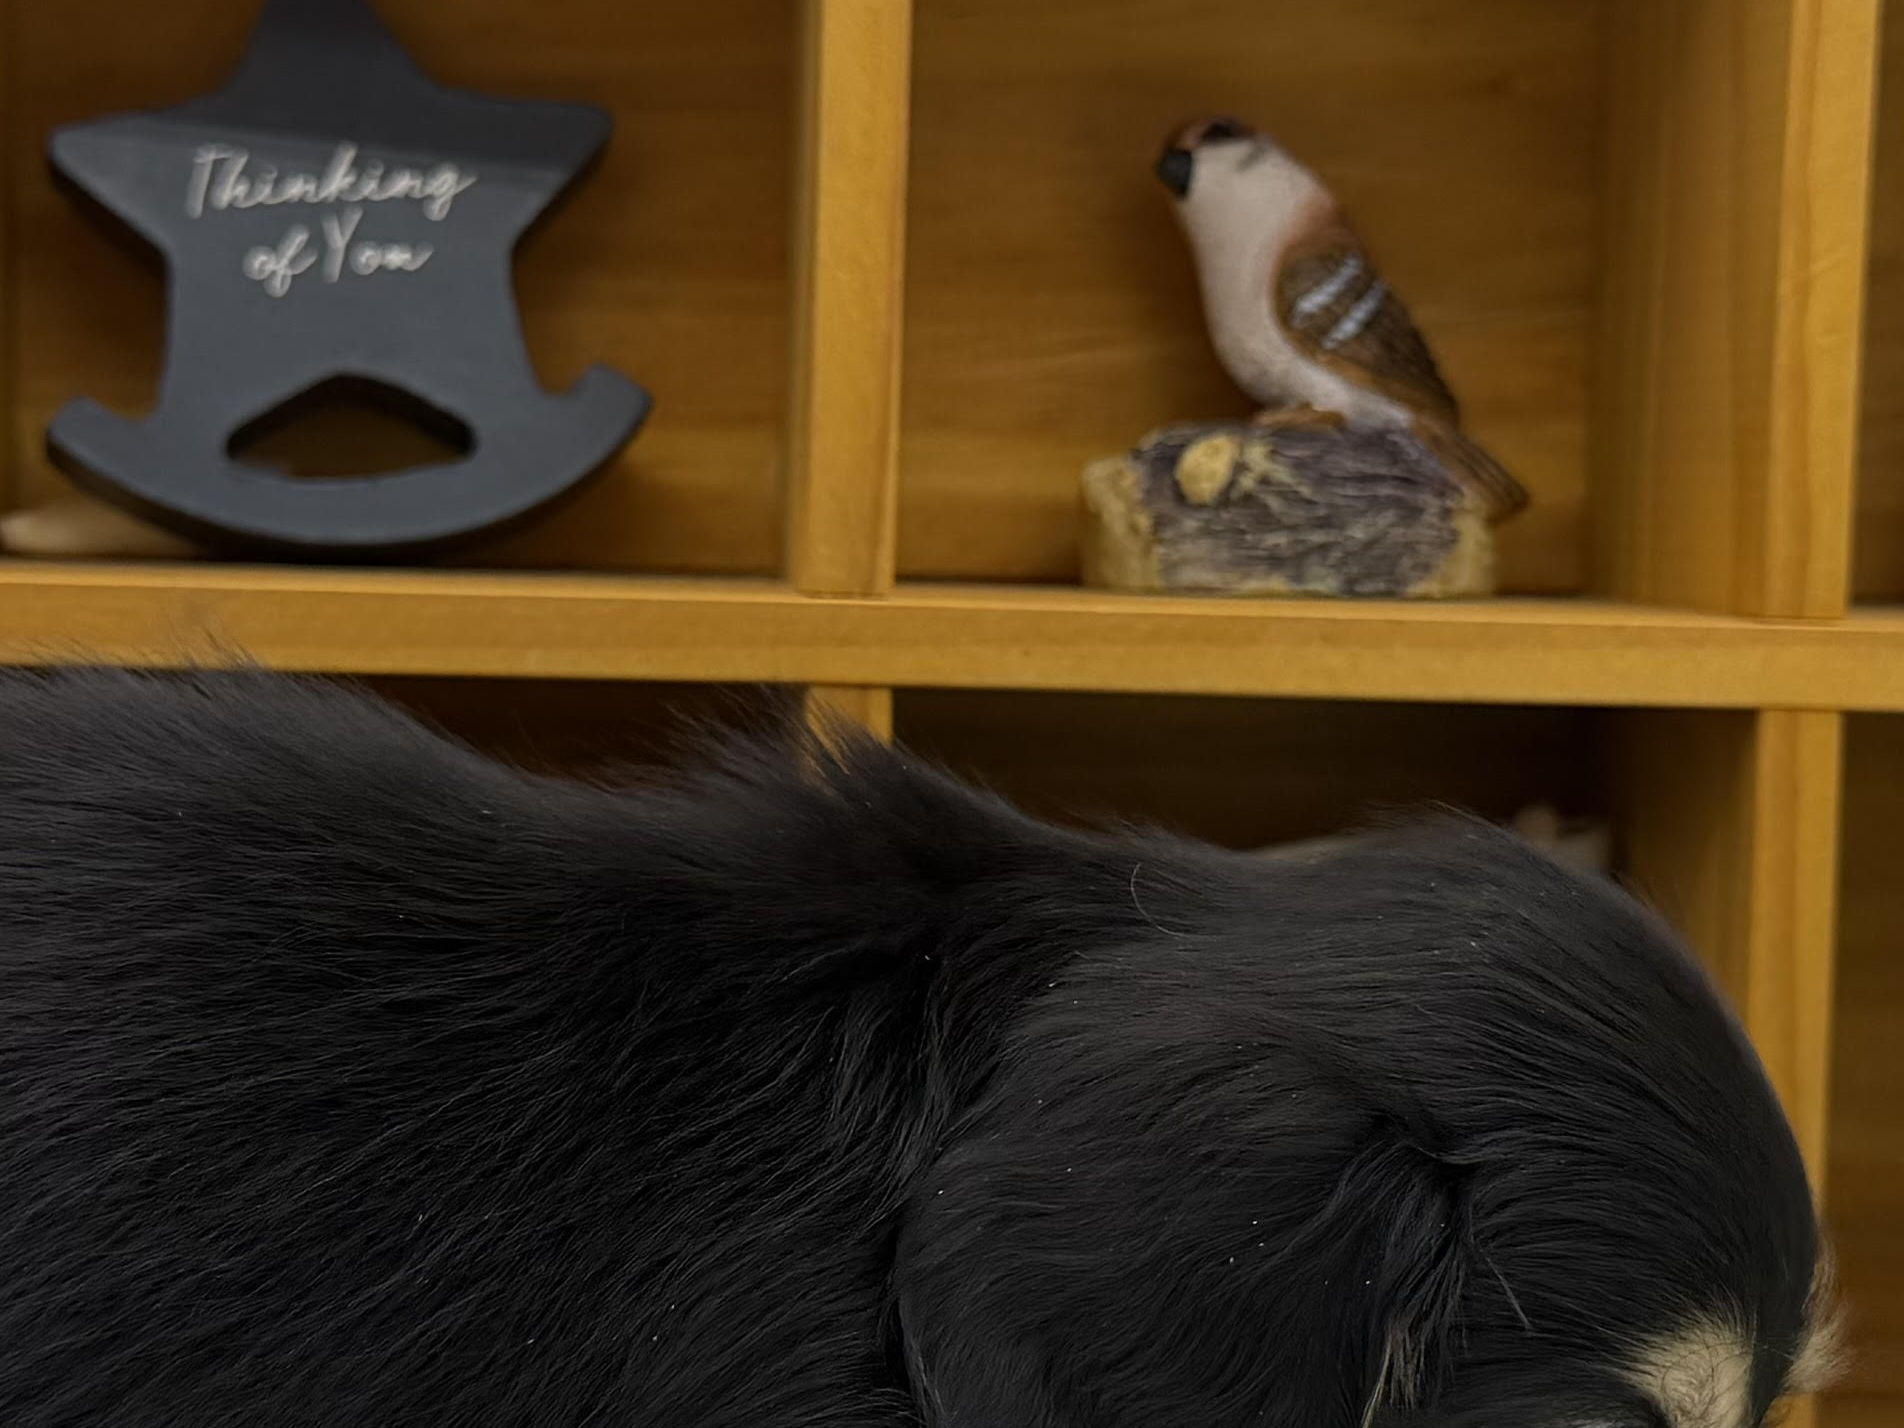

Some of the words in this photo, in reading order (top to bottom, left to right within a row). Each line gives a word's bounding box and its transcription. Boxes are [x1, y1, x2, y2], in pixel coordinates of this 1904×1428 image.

[185, 140, 478, 222] Thinking
[242, 223, 318, 298] of
[319, 204, 434, 284] You
